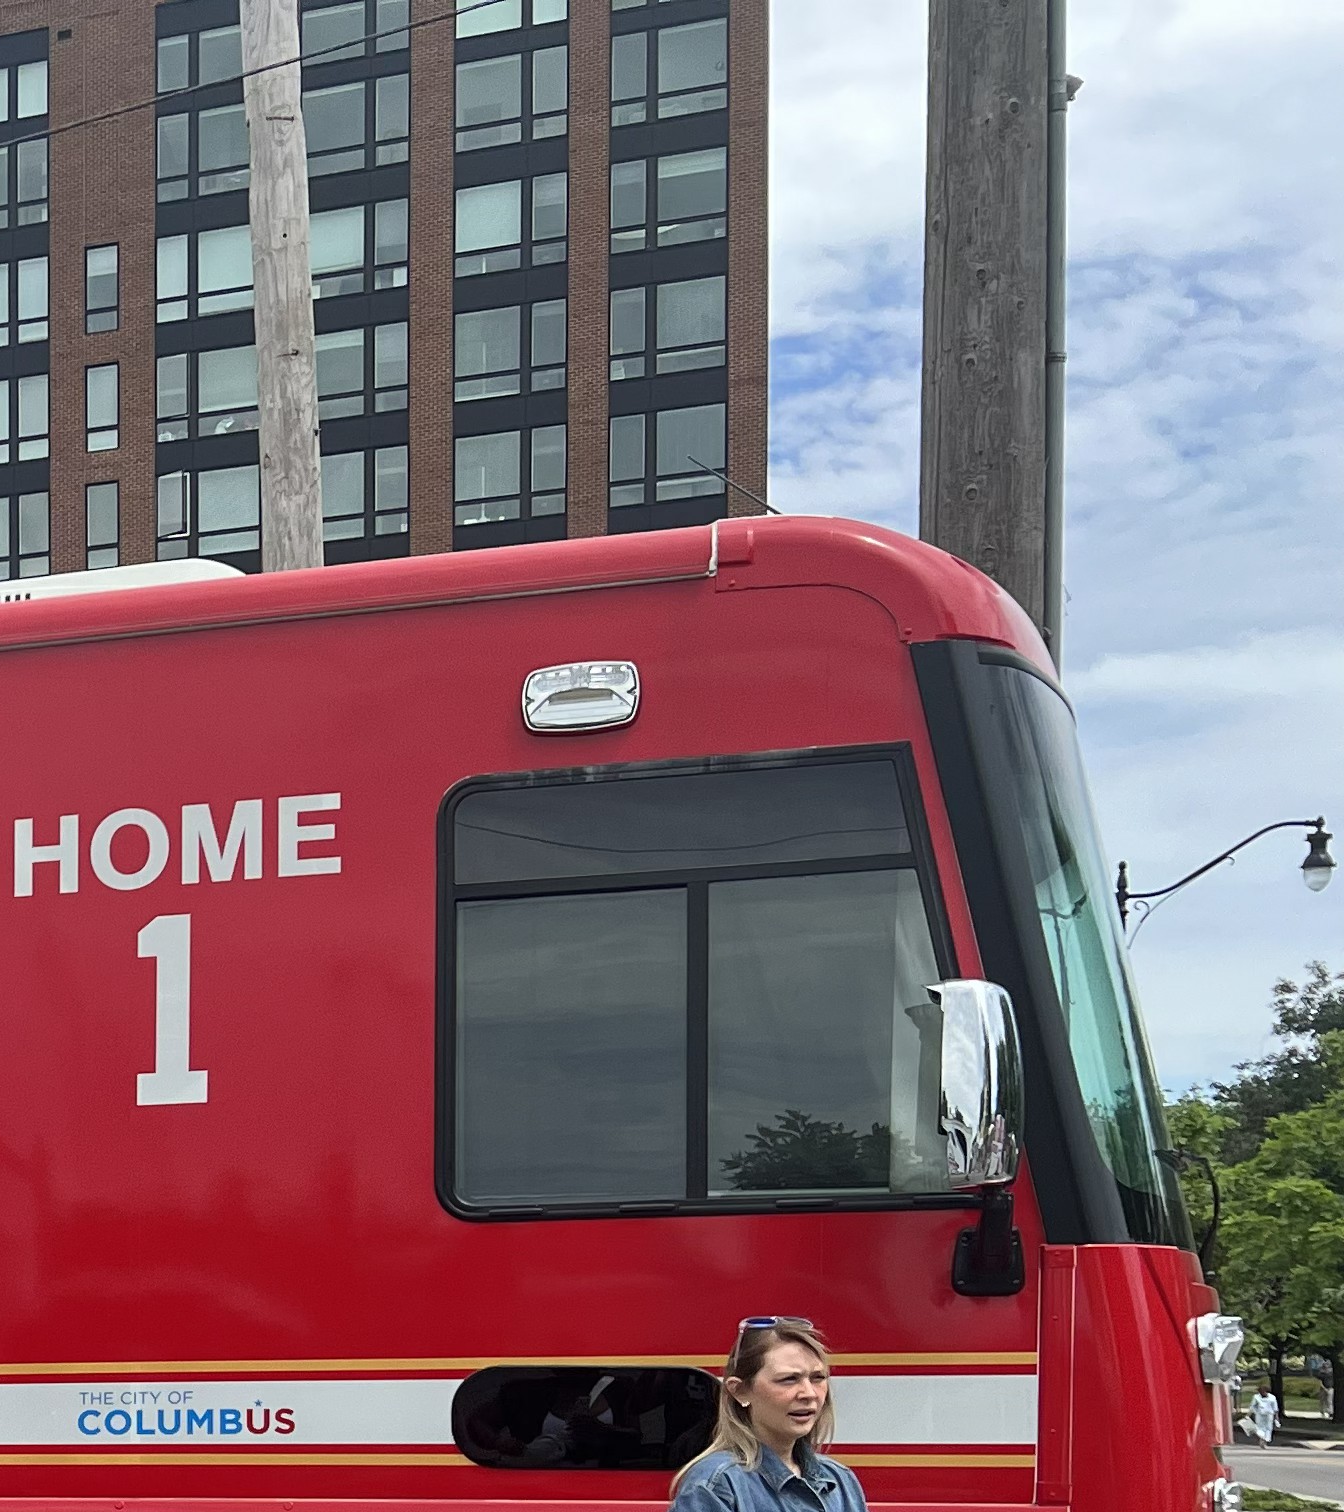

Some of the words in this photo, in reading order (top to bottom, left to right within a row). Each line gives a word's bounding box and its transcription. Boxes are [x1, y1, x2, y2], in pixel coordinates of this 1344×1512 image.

[14, 792, 342, 897] HOME
[137, 914, 209, 1106] 1
[77, 1408, 296, 1435] COLUMBUS
[79, 1391, 114, 1405] THE
[120, 1391, 161, 1405] CITY
[167, 1390, 193, 1405] OF
